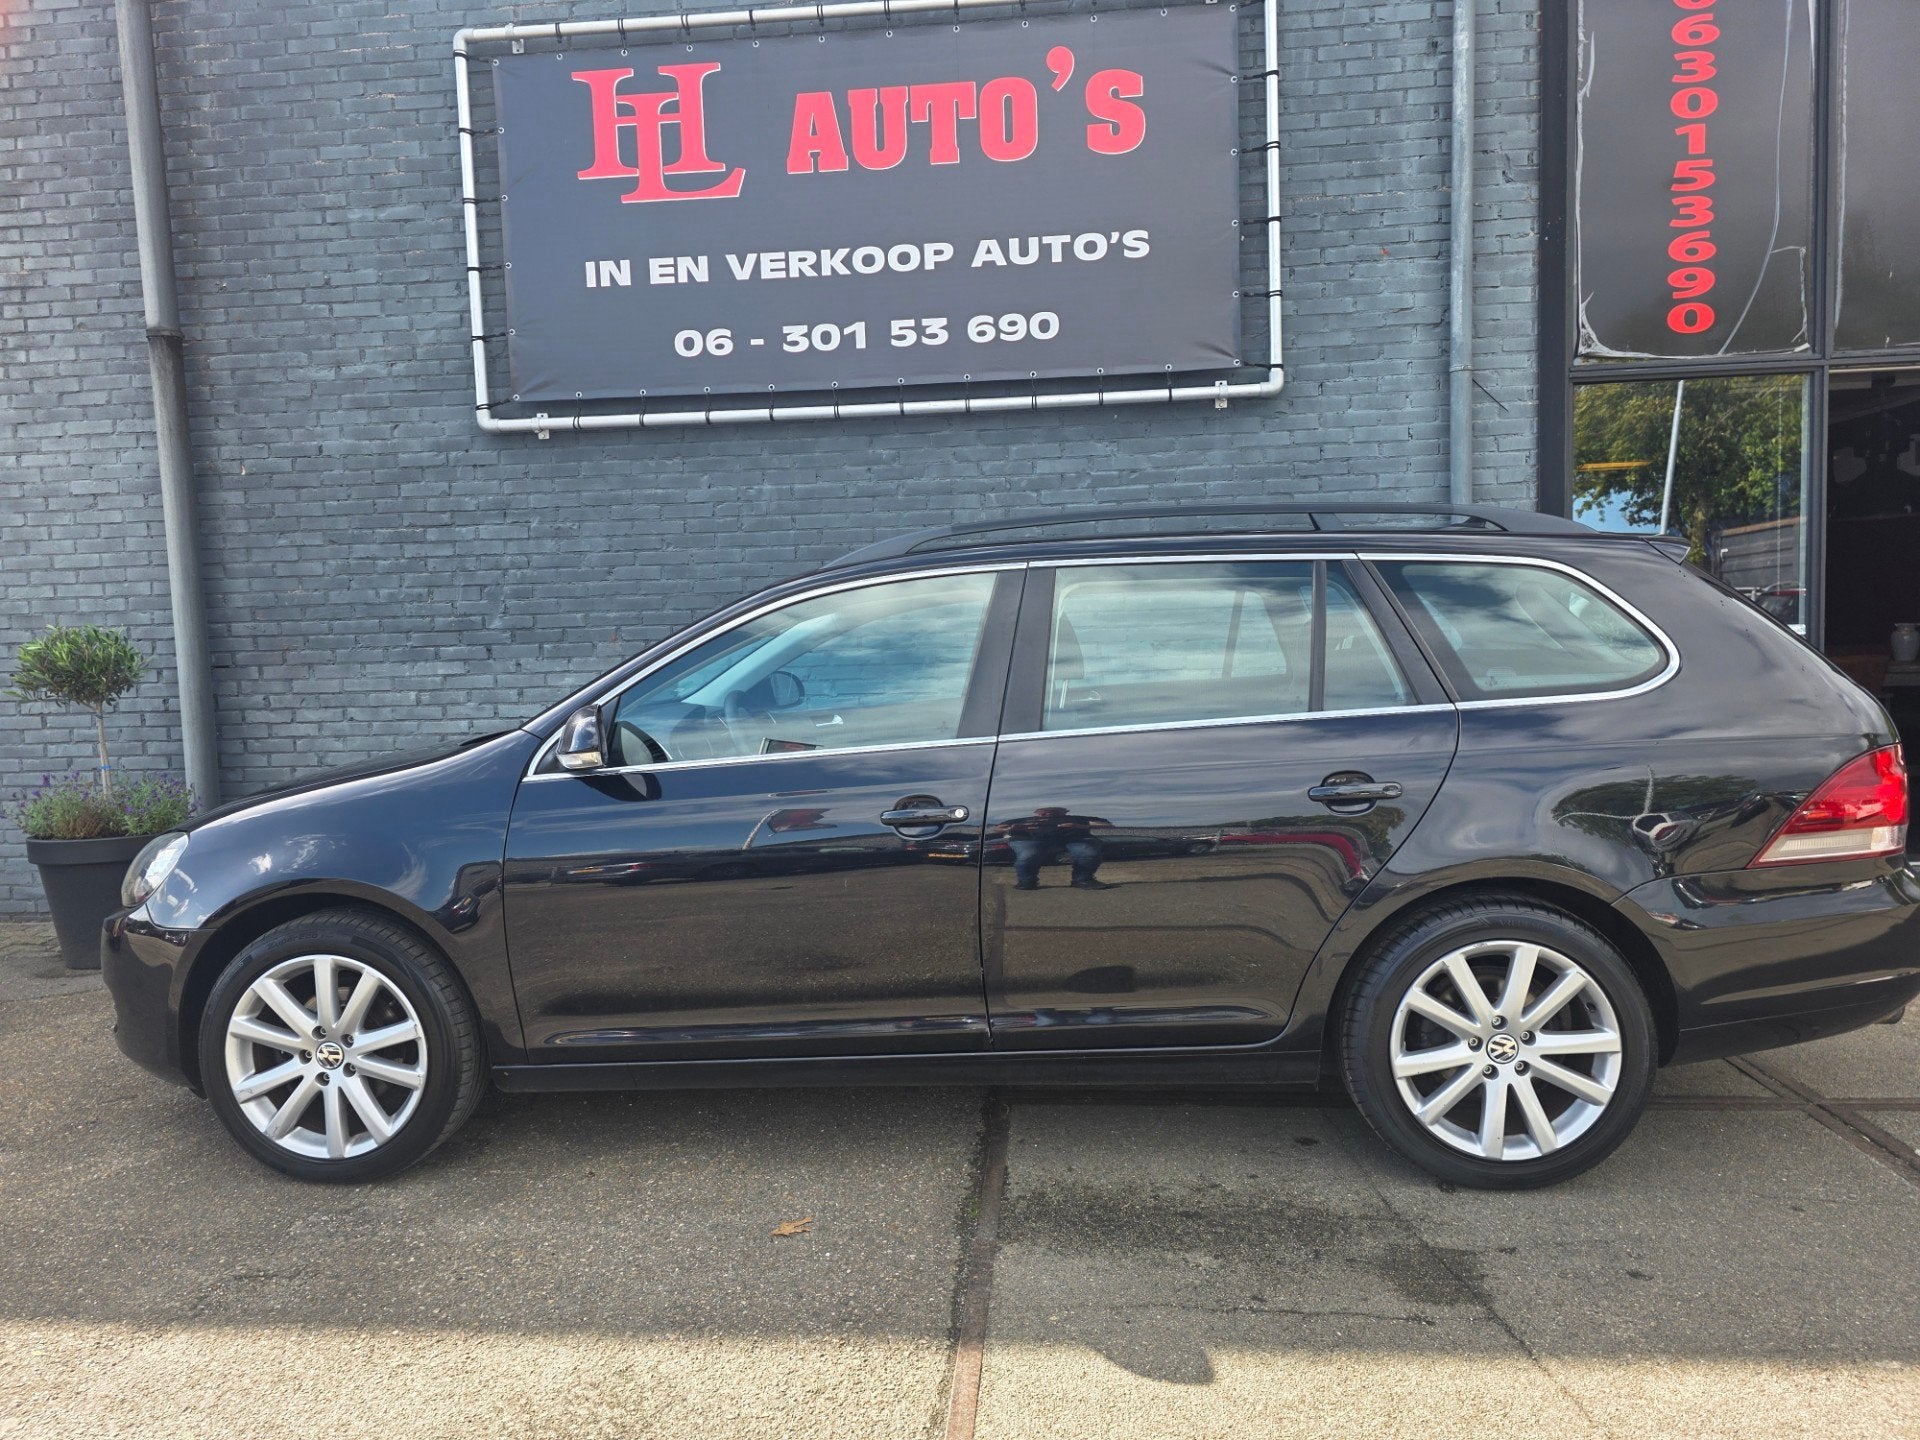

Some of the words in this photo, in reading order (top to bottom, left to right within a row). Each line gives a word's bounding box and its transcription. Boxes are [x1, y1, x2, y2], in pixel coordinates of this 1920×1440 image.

[786, 45, 1147, 174] AUTO'S
[585, 259, 632, 288] IN
[648, 255, 710, 285] EN
[724, 242, 955, 282] VERKOOP
[970, 229, 1151, 268] AUTO'S
[674, 328, 734, 358] 06
[750, 338, 765, 346] -
[782, 321, 868, 353] 301
[890, 317, 949, 348] 53
[967, 311, 1060, 344] 690
